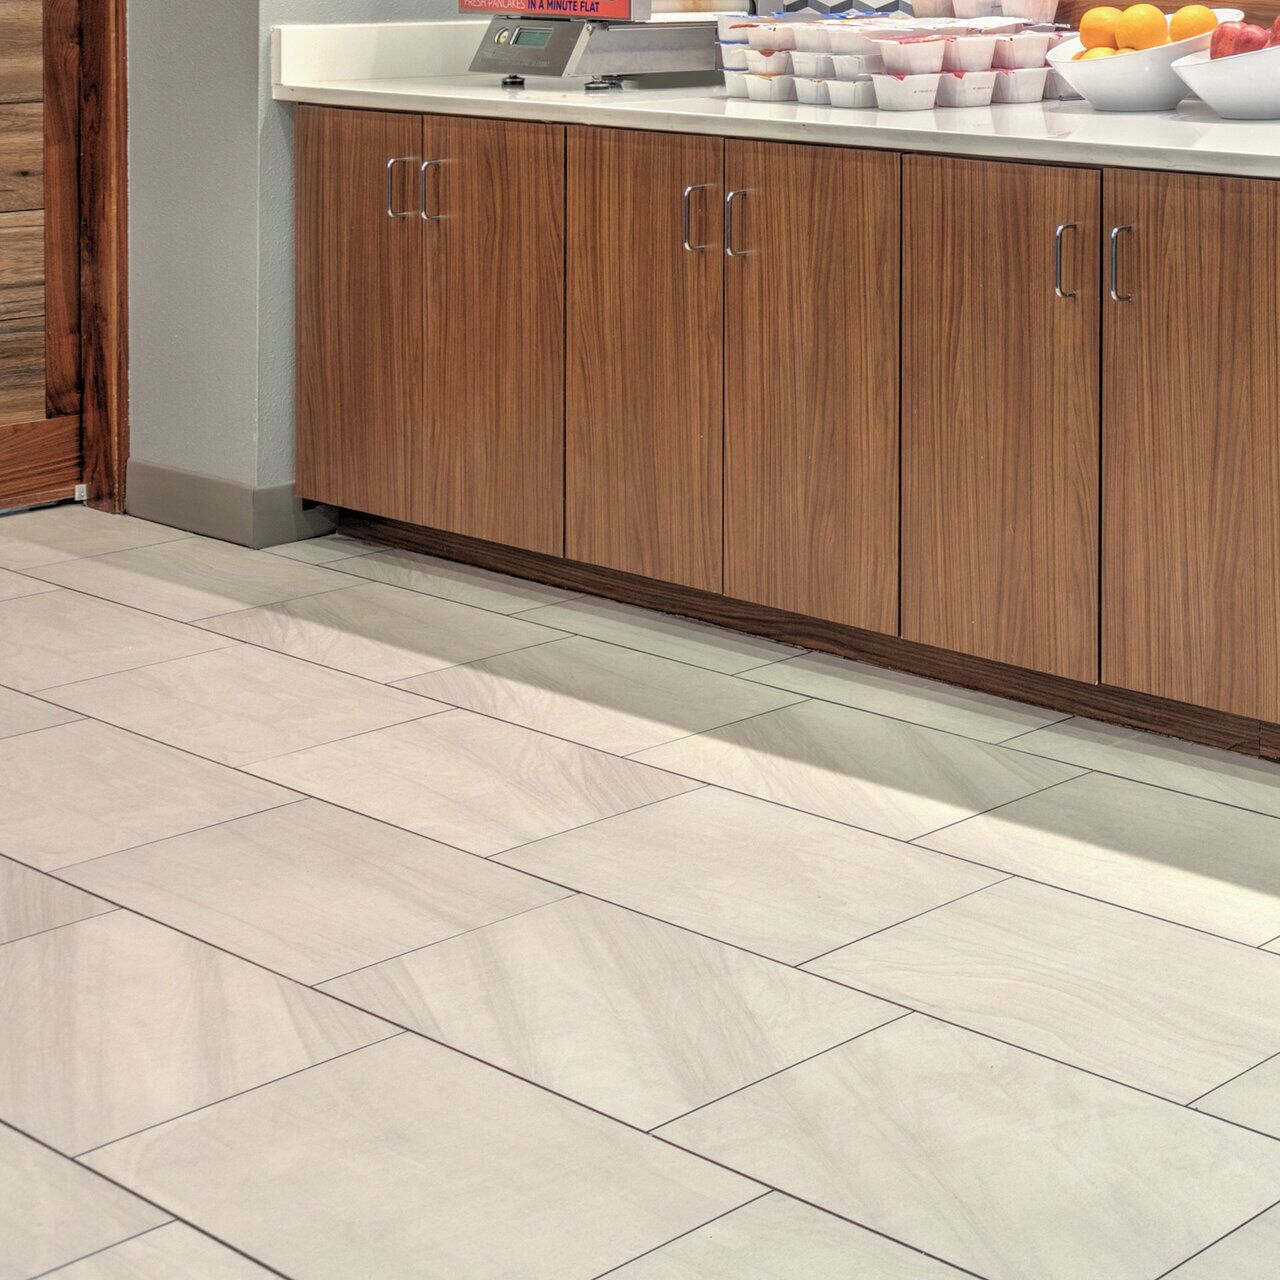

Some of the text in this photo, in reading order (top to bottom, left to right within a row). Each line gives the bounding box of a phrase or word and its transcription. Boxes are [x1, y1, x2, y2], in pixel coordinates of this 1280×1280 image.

[538, 0, 544, 9] A
[547, 0, 578, 11] MINUTE
[580, 1, 600, 12] FLAT
